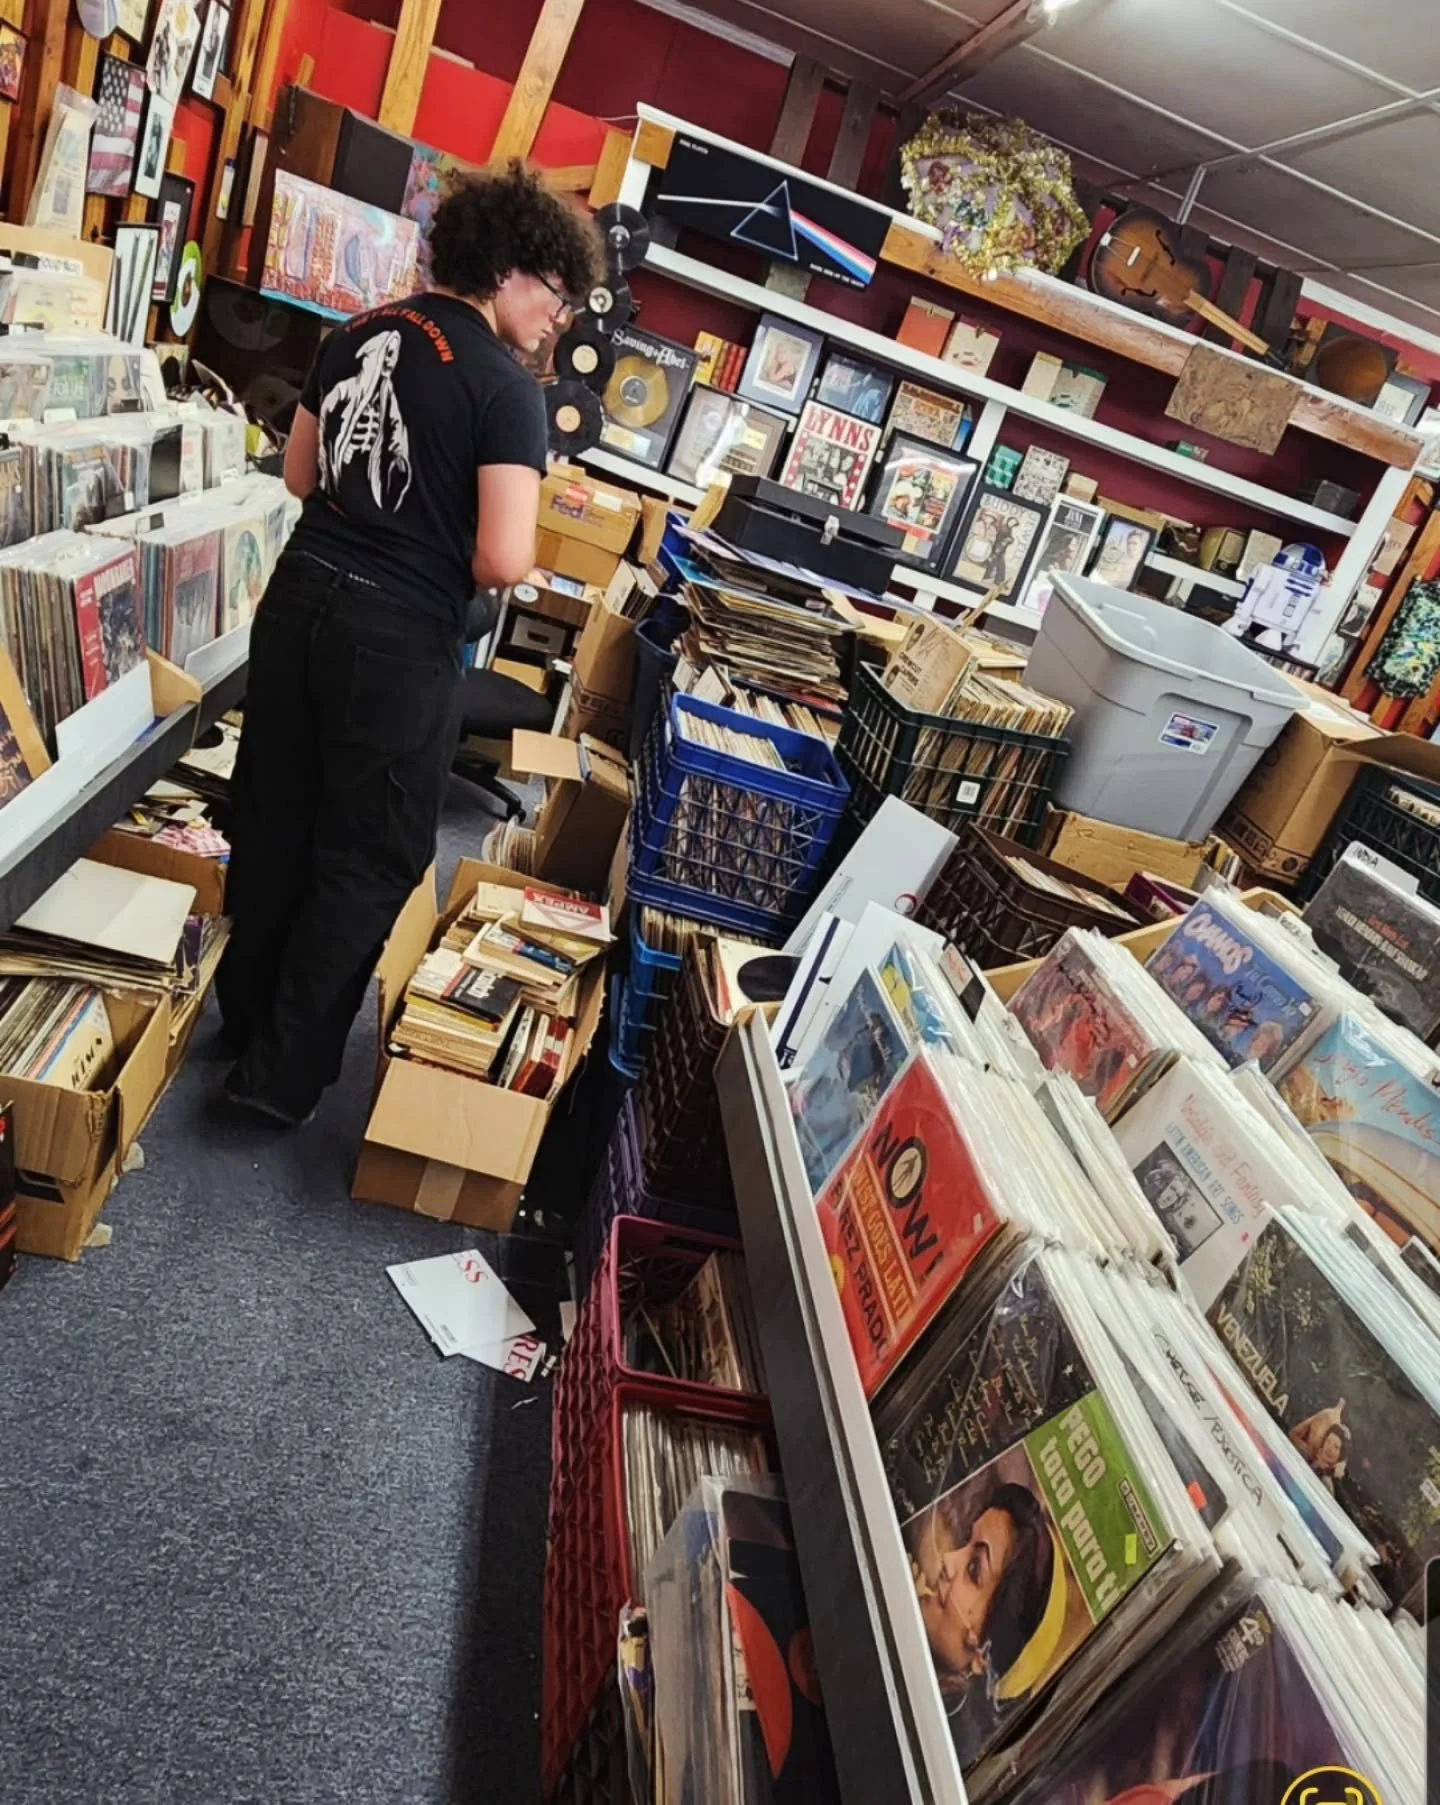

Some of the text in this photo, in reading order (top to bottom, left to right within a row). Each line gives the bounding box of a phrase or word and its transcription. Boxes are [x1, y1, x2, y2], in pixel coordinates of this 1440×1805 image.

[422, 319, 455, 364] DOWN
[804, 404, 874, 453] LYNNS
[831, 1180, 860, 1262] PREZ
[867, 1210, 892, 1265] GOES
[1217, 1304, 1289, 1416] VENEZUELA
[1059, 1405, 1107, 1489] PEGO
[1040, 1435, 1128, 1612] toco para ti
